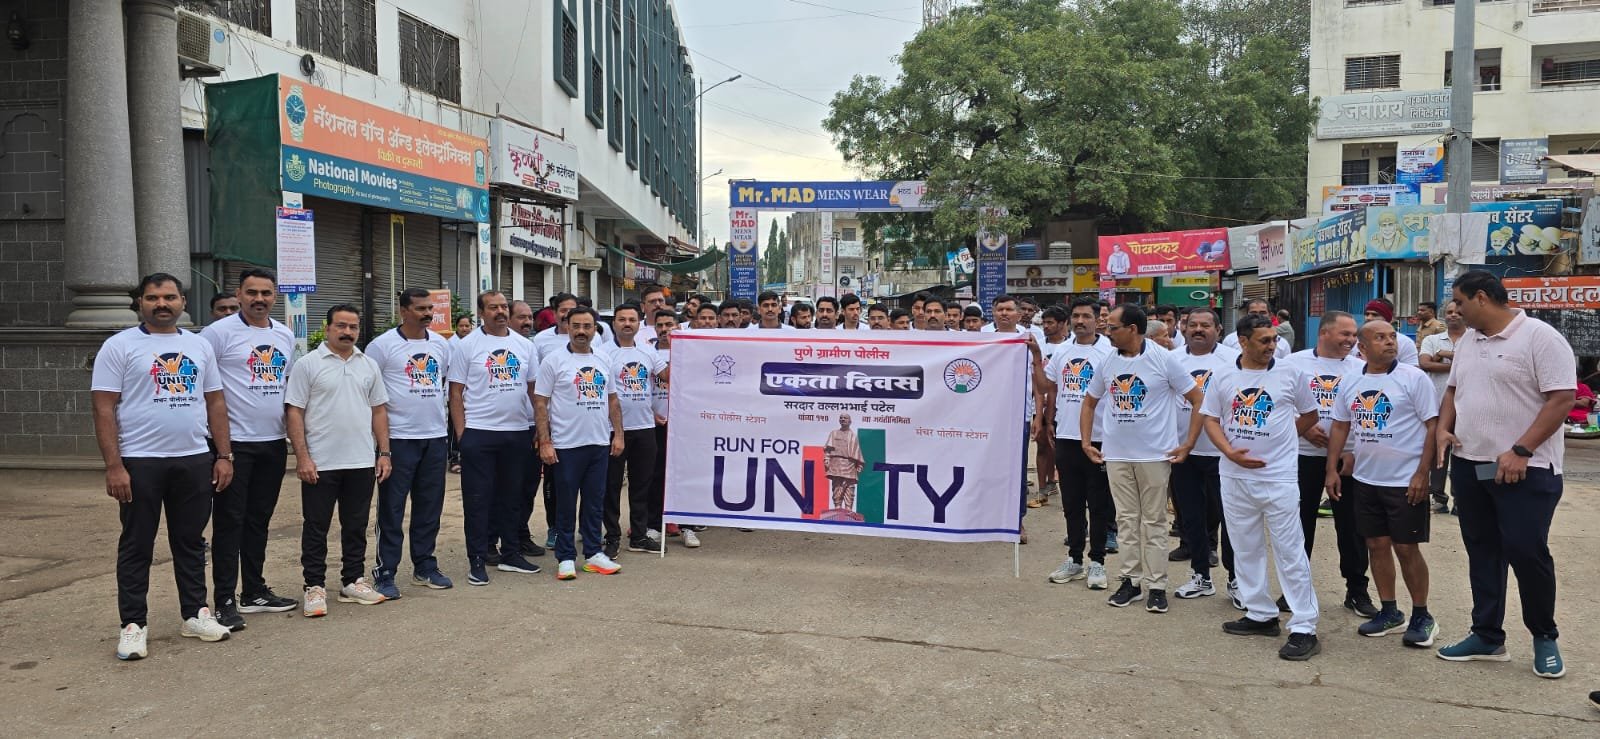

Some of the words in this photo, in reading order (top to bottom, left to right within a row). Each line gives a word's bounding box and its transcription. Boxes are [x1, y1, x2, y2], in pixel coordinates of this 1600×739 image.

[1342, 95, 1406, 121] जनप्रिय
[313, 104, 357, 138] नॅशनल
[360, 118, 385, 144] वॉच
[308, 157, 359, 184] National
[361, 170, 398, 191] Movies
[313, 178, 355, 198] Photography
[818, 189, 850, 201] MENS
[852, 189, 888, 201] WEAR
[736, 210, 753, 219] Mr.
[1503, 206, 1534, 225] सेंटर
[732, 219, 756, 228] MAD
[1505, 281, 1569, 303] बजरंग
[794, 346, 813, 361] पुणे
[816, 346, 850, 360] ग्रामीण
[854, 347, 890, 360] पोलीस
[157, 376, 196, 385] UNITY
[764, 373, 840, 390] एकता
[843, 371, 921, 391] दिवस
[1064, 377, 1090, 385] UNITY
[1113, 395, 1144, 403] UNITY
[784, 401, 815, 411] सरदार
[817, 401, 868, 413] वल्लभभाई
[870, 402, 896, 413] पटेल
[1234, 409, 1270, 418] UNITY
[1354, 413, 1390, 421] UNITY
[915, 426, 933, 437] मंचर
[937, 428, 962, 438] पोलीस
[965, 429, 989, 440] स्टेशन
[714, 437, 754, 453] RUN
[761, 439, 800, 455] FOR
